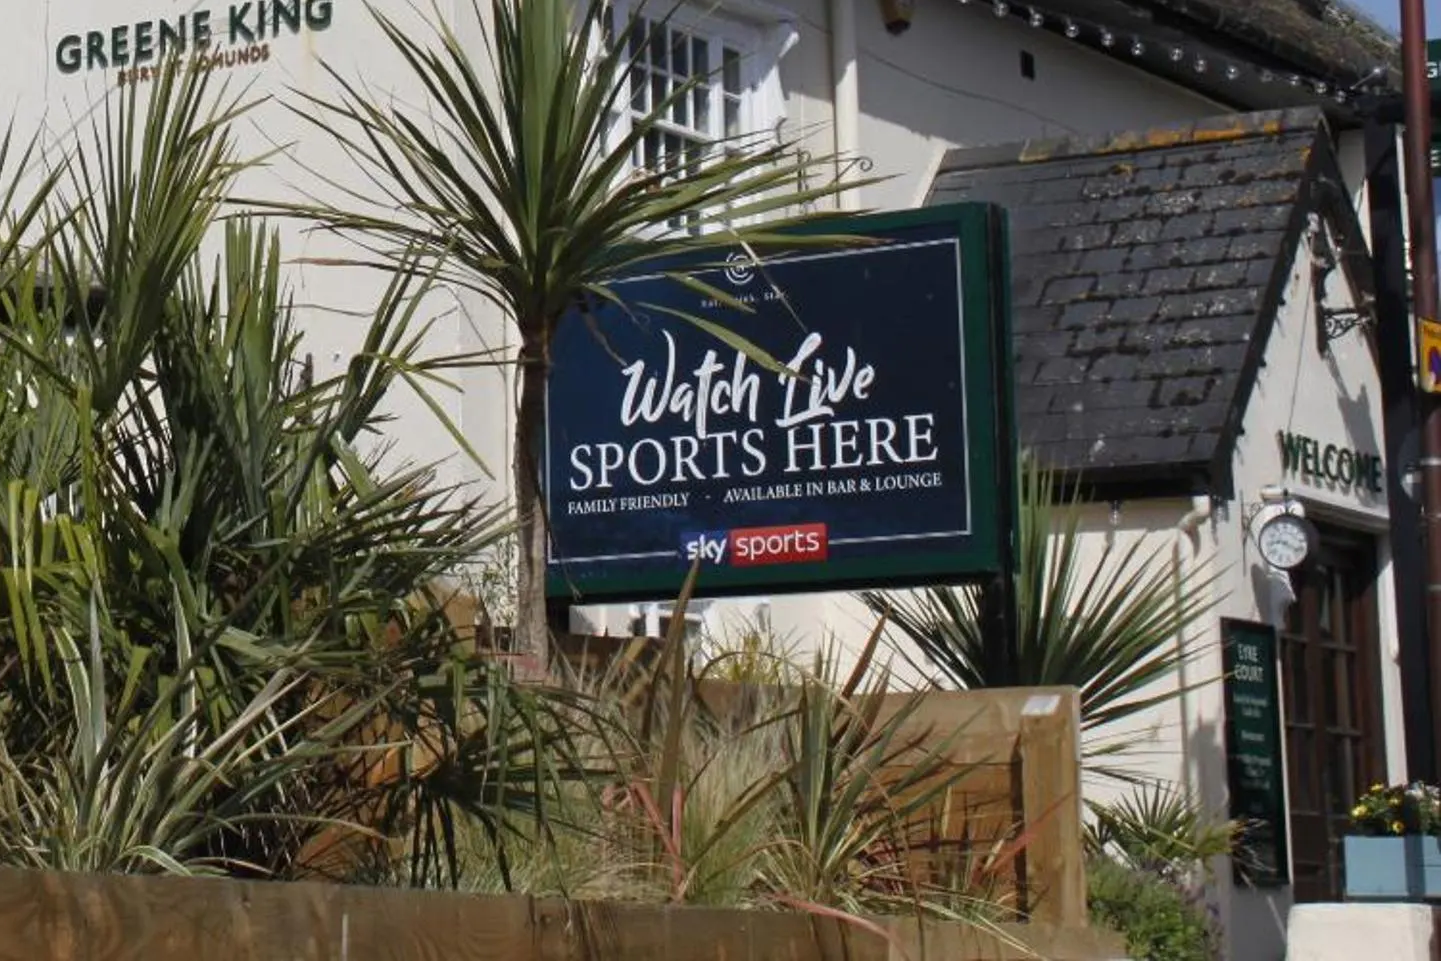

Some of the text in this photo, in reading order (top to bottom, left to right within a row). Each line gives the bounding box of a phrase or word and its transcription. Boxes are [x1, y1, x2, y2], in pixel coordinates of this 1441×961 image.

[56, 9, 211, 74] GREENE
[194, 43, 270, 74] DMUNDS
[620, 330, 875, 438] Watch Live
[569, 412, 939, 492] SPORTS HERE
[1276, 429, 1383, 493] WELCOME
[567, 498, 617, 515] FAMILY
[619, 492, 691, 511] FRIENDLY
[723, 483, 803, 504] AVAILABLE
[806, 481, 824, 496] IN
[827, 479, 852, 494] BAR
[860, 477, 871, 492] &
[875, 472, 943, 491] LOUNGE
[686, 528, 820, 565] sky sports
